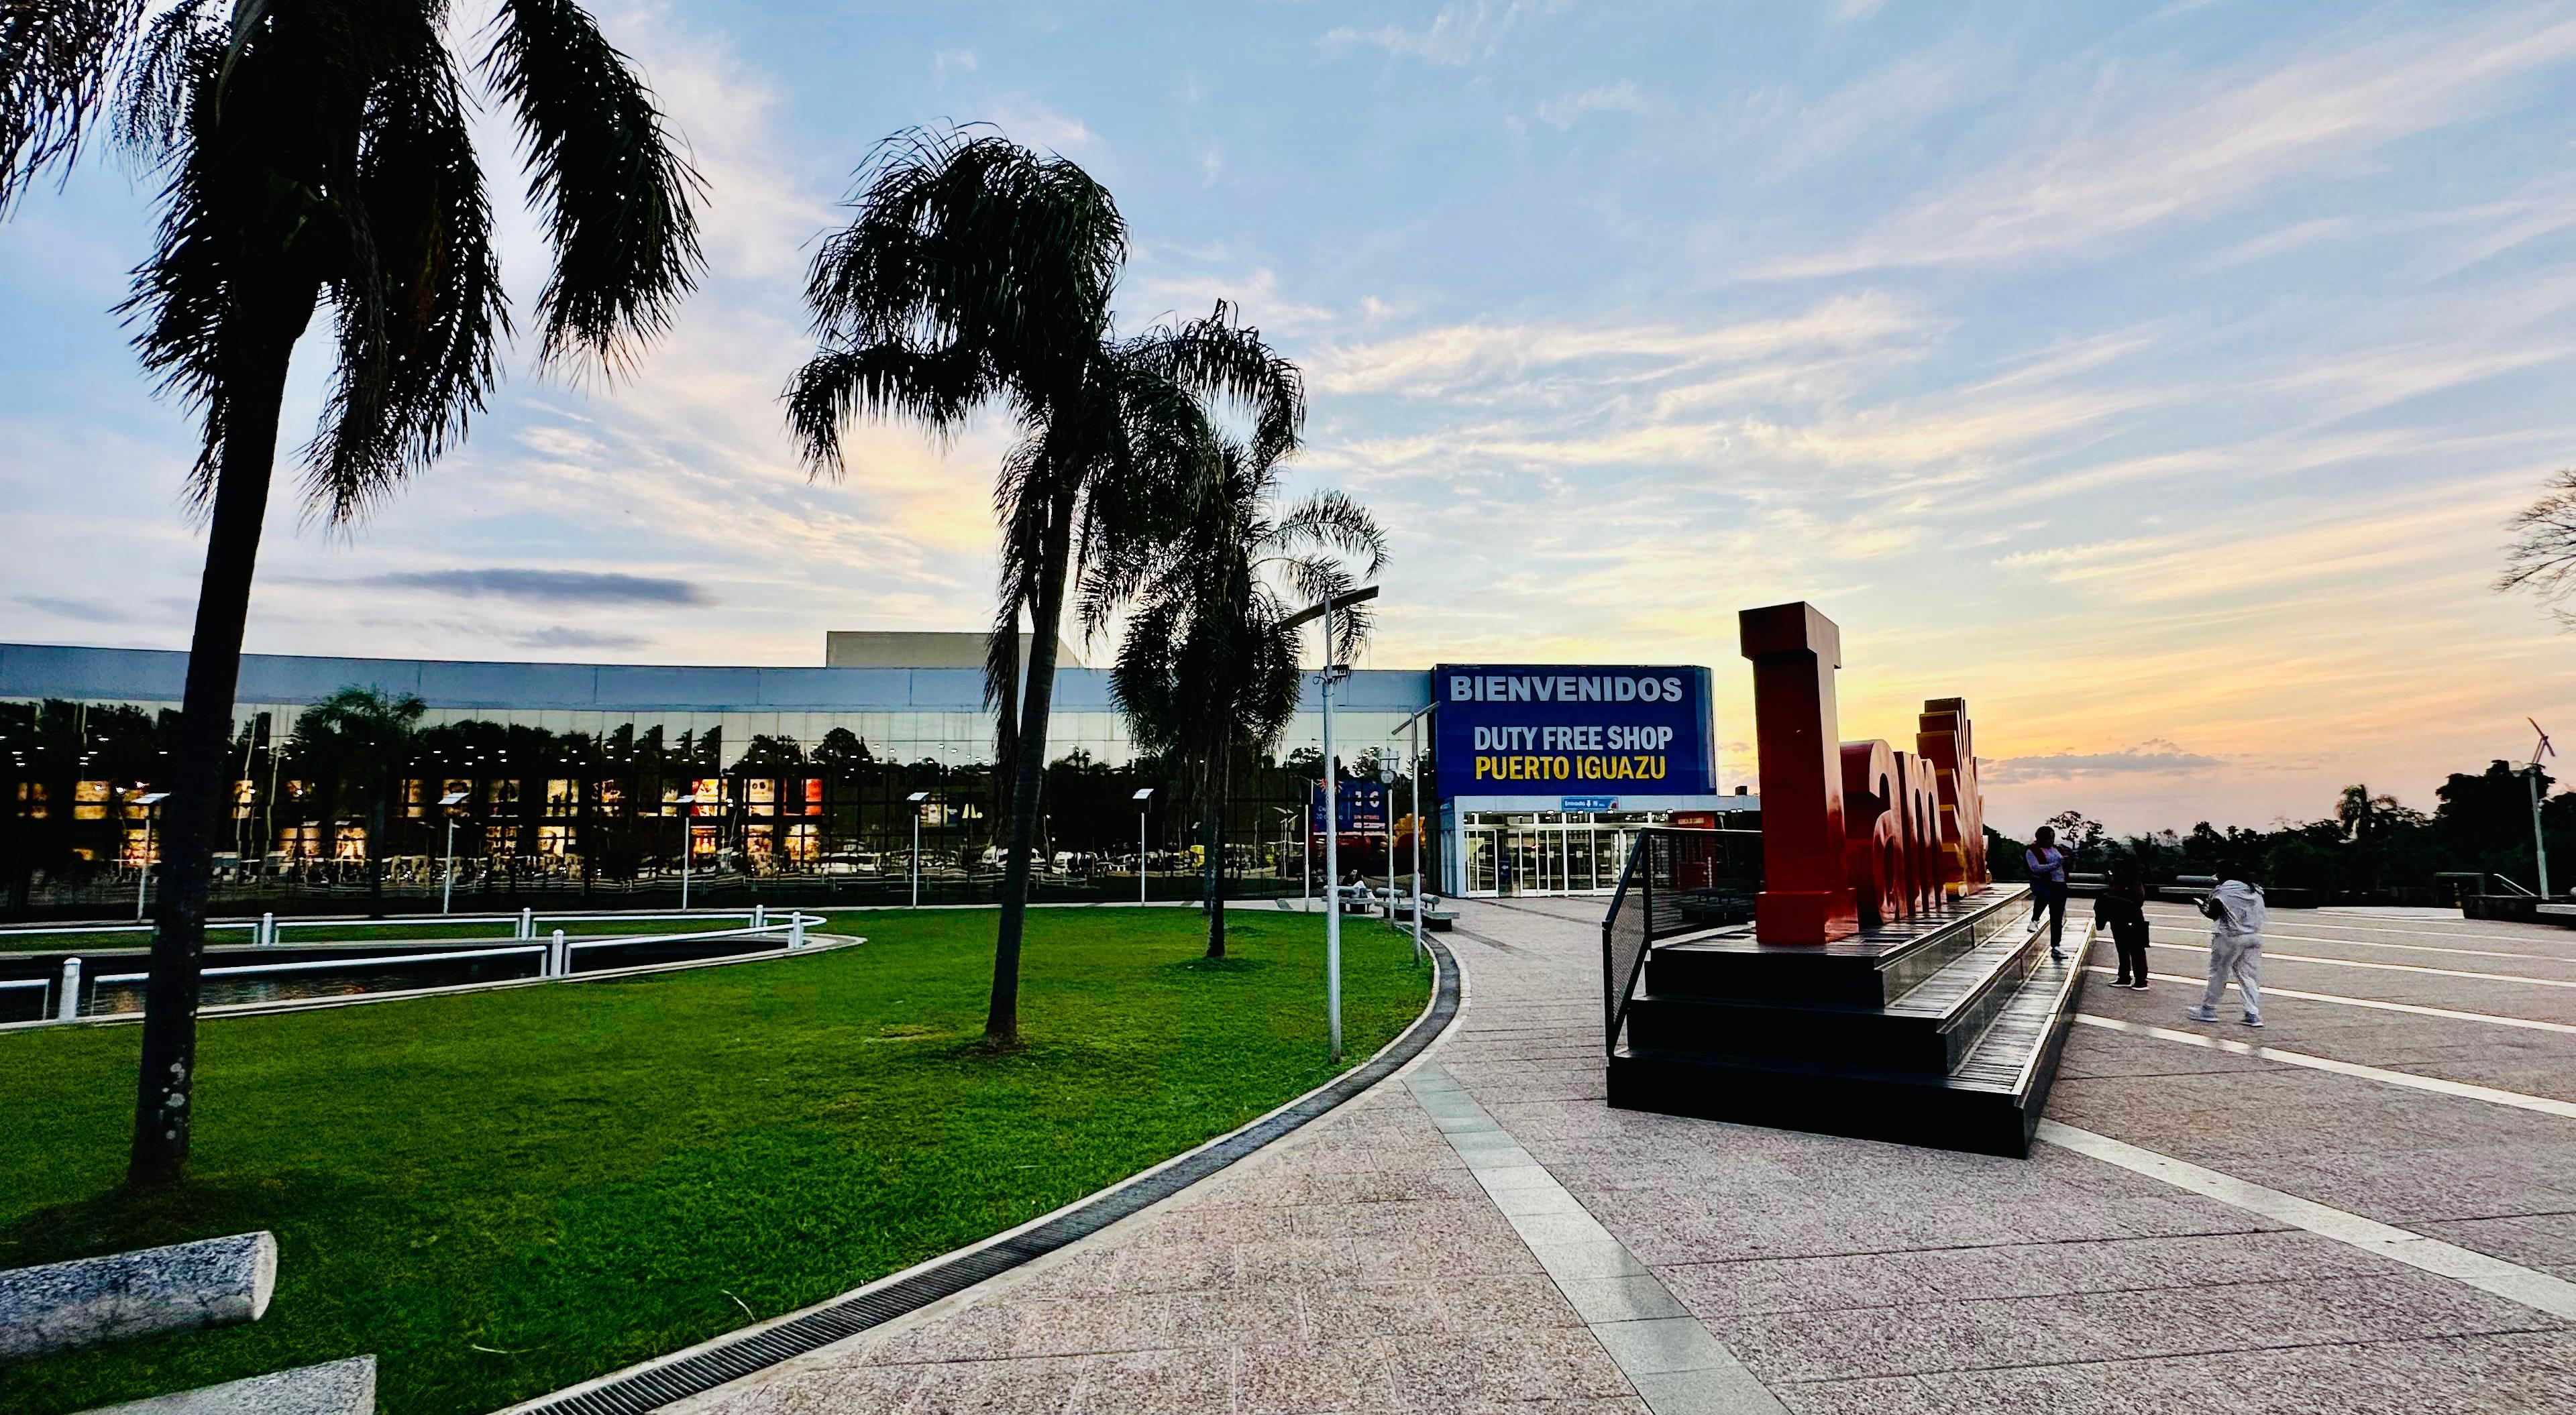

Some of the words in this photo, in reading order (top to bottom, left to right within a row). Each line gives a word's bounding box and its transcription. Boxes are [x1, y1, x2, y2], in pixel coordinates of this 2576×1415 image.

[1450, 676, 1682, 702] BIENVENIDOS
[1474, 726, 1538, 750] DUTY
[1543, 726, 1604, 750] FREE
[1607, 725, 1673, 750] SHOP
[1475, 756, 1570, 780] PUERTO
[1576, 755, 1666, 779] IGUAZU
